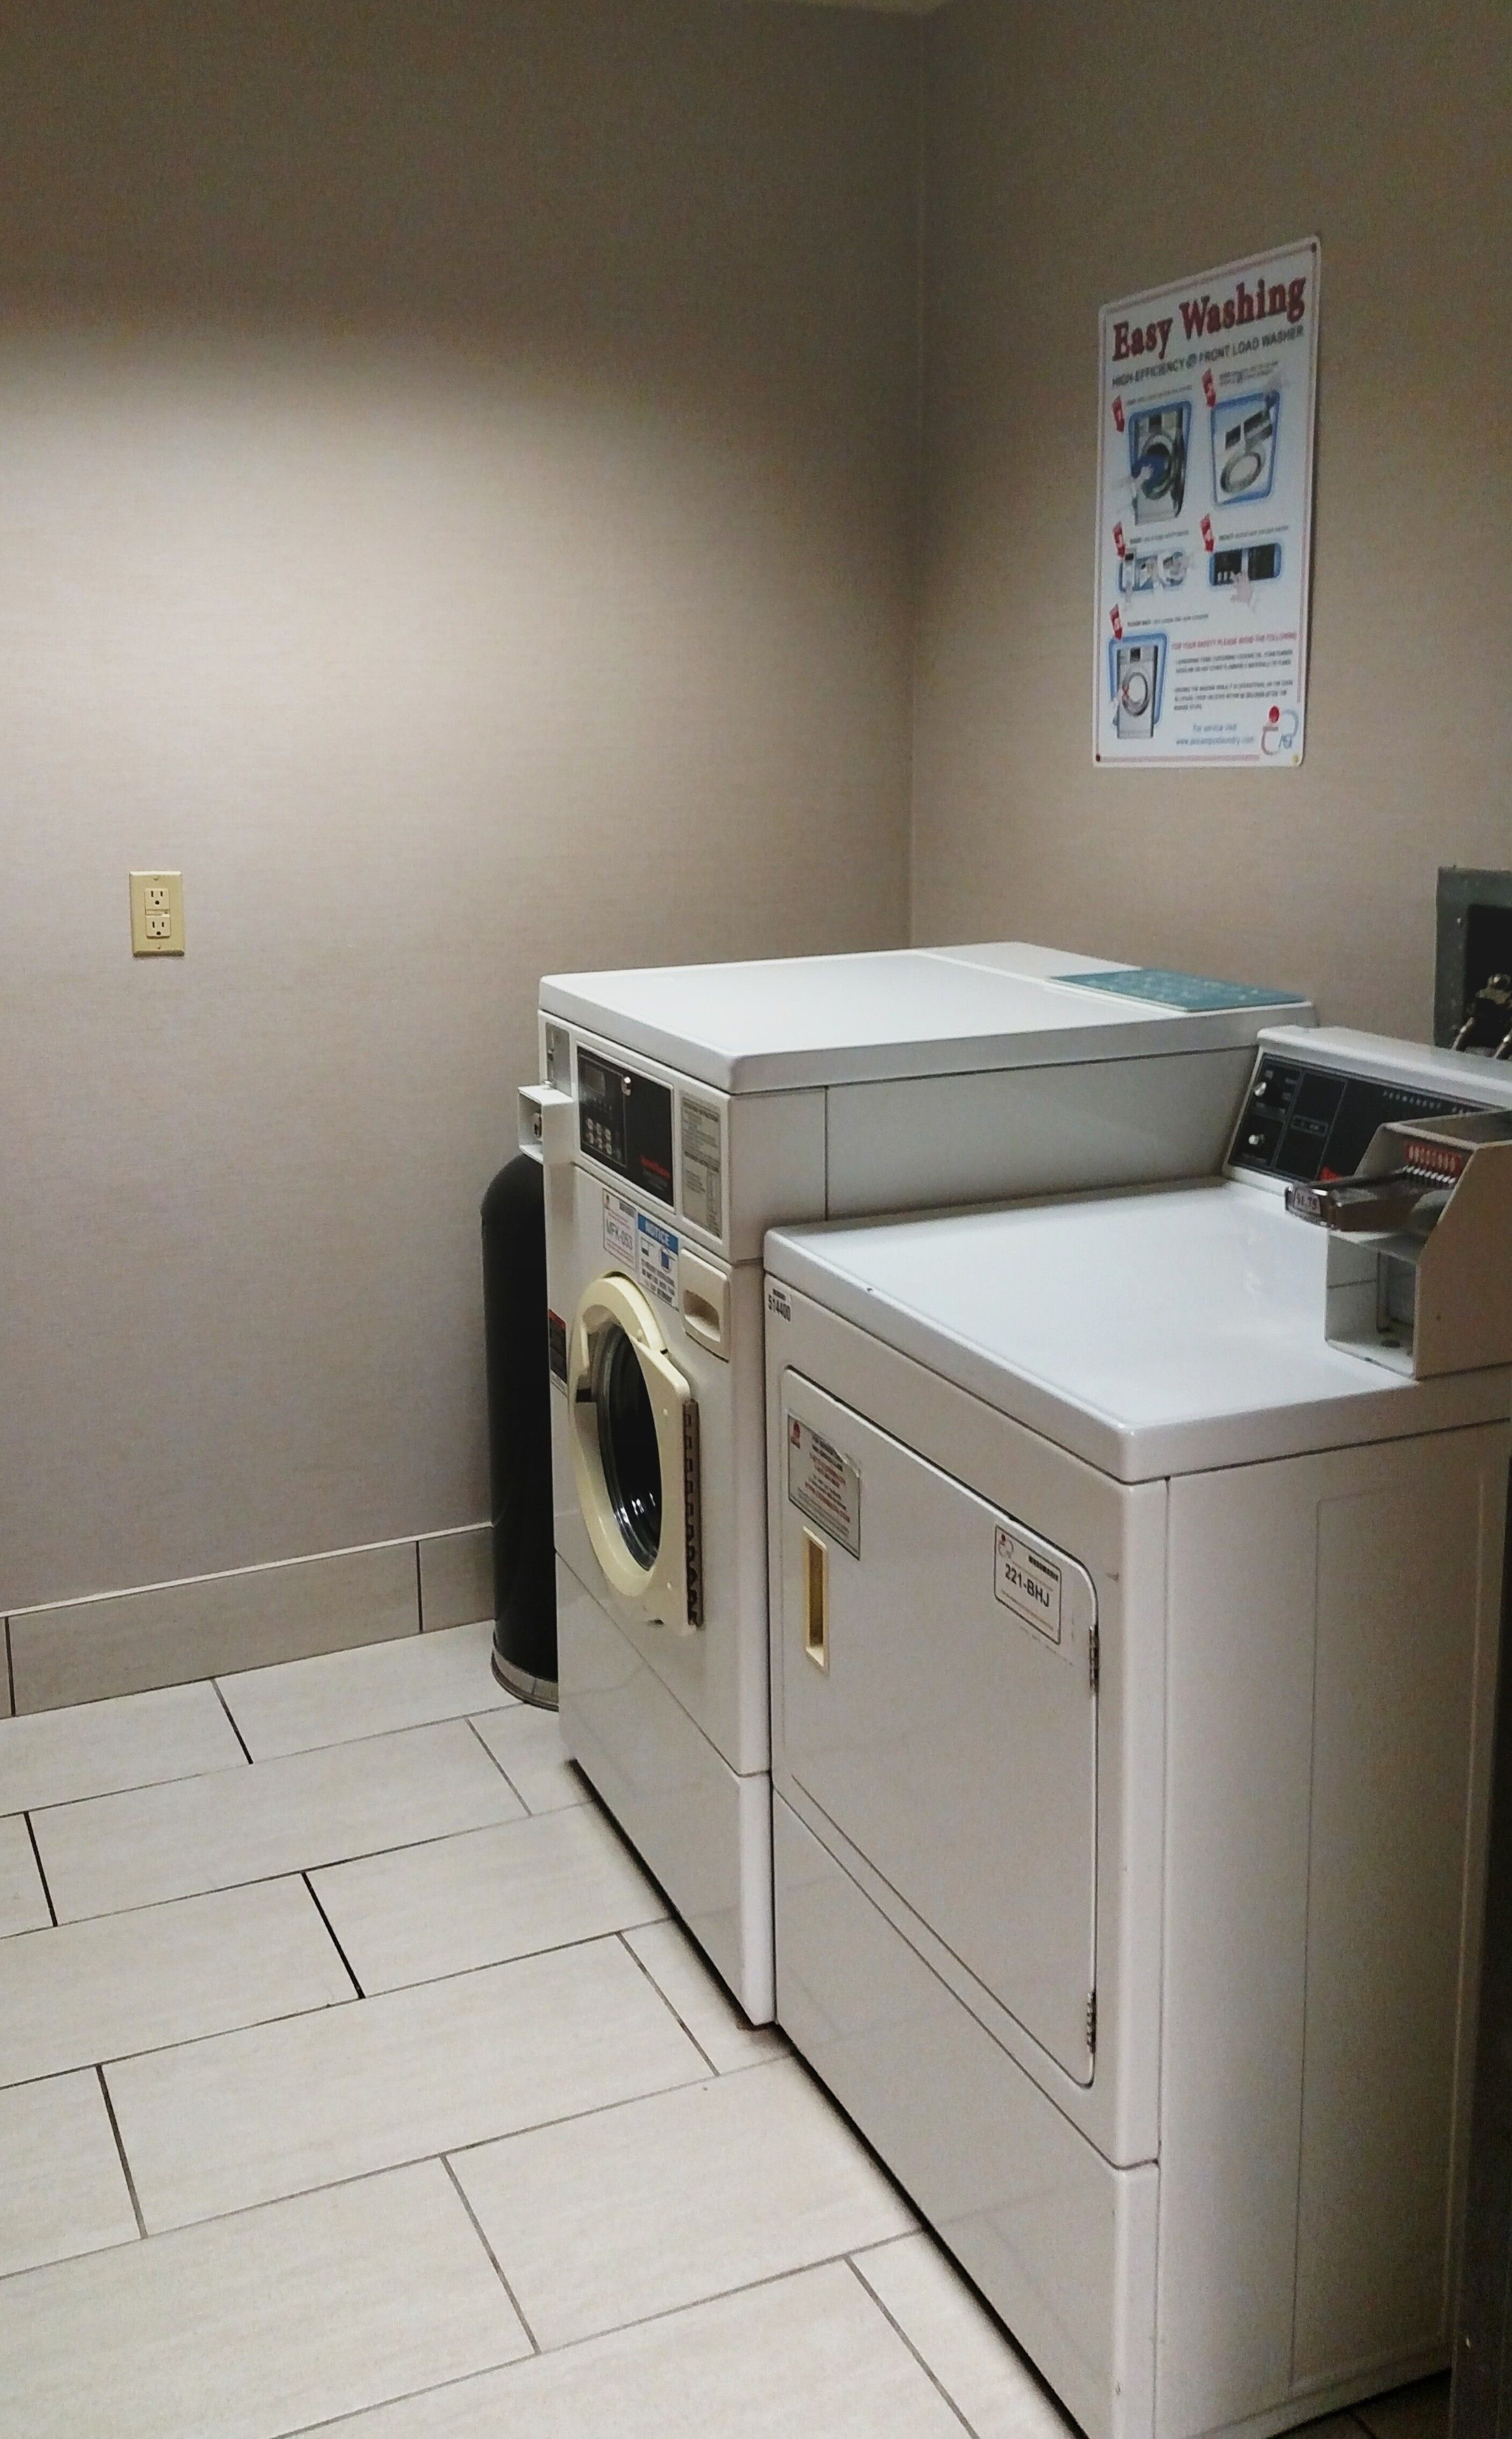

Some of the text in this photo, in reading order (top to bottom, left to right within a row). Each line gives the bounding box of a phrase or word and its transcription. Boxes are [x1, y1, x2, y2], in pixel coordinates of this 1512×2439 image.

[1113, 277, 1306, 361] Easy Washing
[1135, 358, 1185, 382] EFFICIENCY
[1199, 343, 1230, 362] FRONT
[1233, 336, 1260, 356] LOAD
[1262, 325, 1304, 347] WASHER
[645, 1219, 671, 1247] NOTICE
[1005, 1562, 1050, 1608] 221-BHJ
